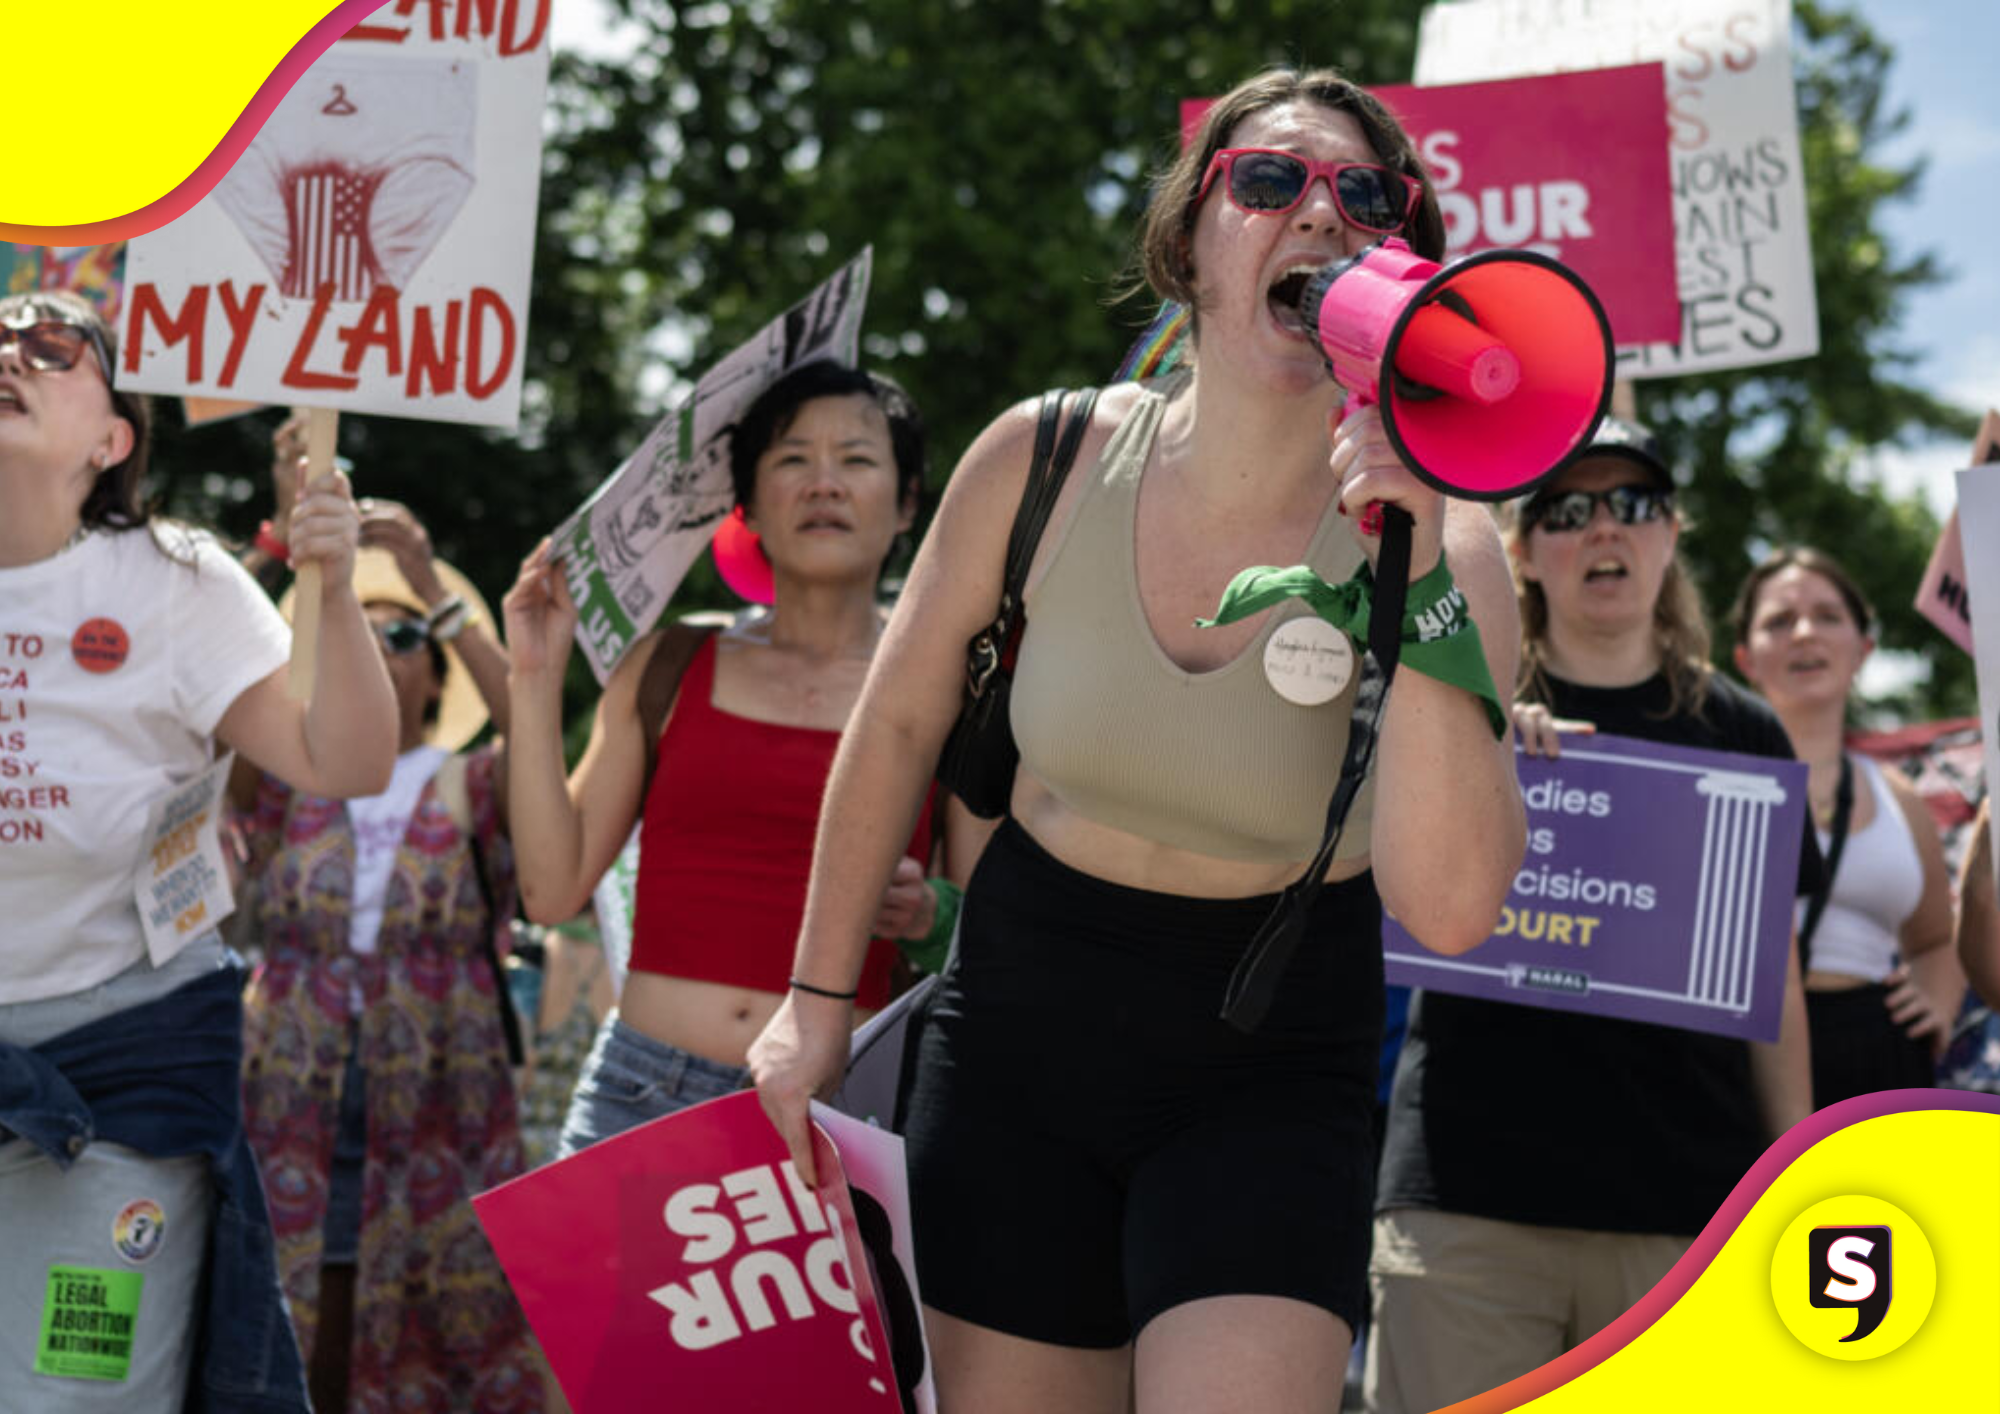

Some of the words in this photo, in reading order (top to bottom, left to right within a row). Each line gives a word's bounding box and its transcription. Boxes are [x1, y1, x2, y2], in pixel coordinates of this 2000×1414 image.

[1410, 130, 1462, 191] S
[123, 279, 267, 389] MY
[281, 282, 517, 401] LAND
[6, 634, 44, 659] TO
[589, 605, 624, 663] us
[1520, 779, 1612, 819] dies
[0, 820, 44, 844] ON
[1526, 827, 1555, 855] s
[1512, 864, 1657, 911] cisions
[663, 1159, 838, 1264] IES
[54, 1281, 108, 1308] LEGAL
[51, 1307, 133, 1337] ABORTION
